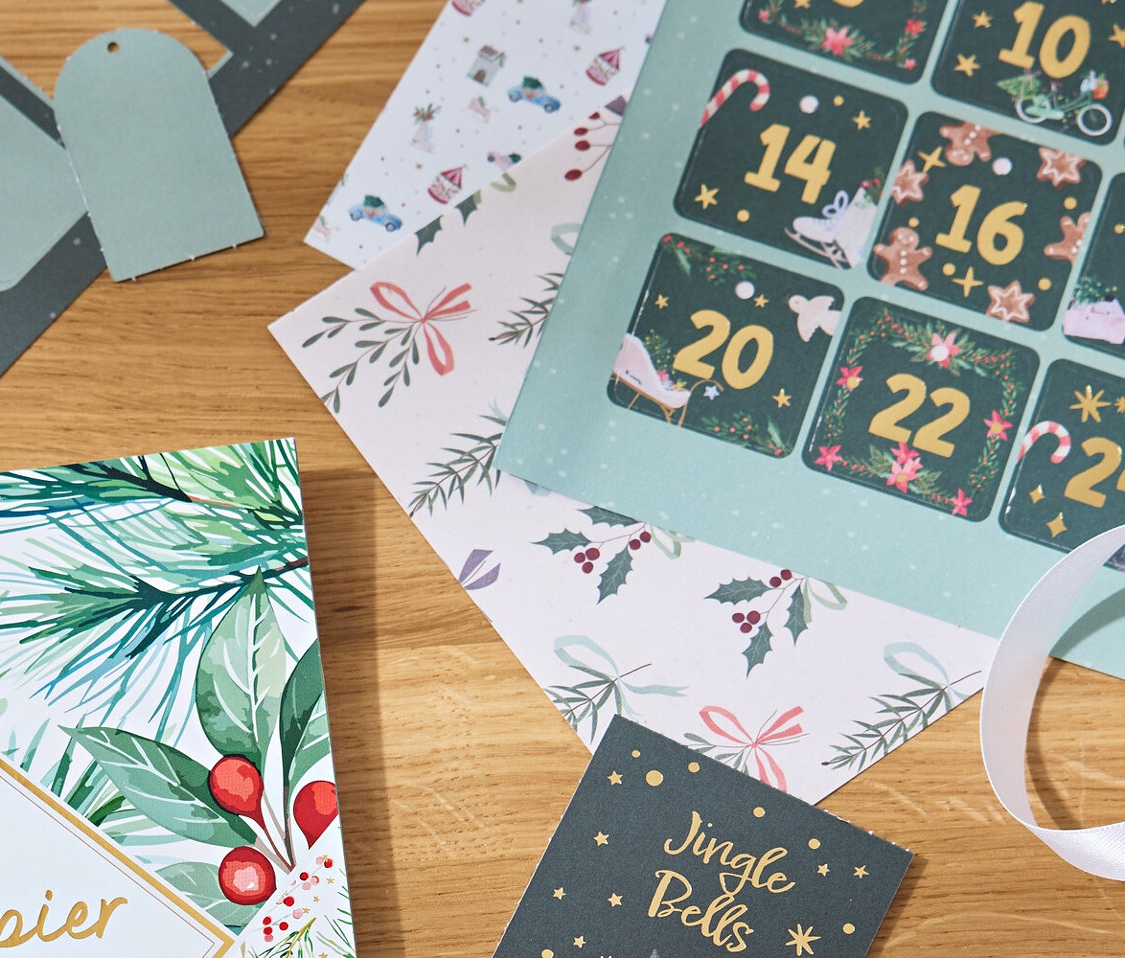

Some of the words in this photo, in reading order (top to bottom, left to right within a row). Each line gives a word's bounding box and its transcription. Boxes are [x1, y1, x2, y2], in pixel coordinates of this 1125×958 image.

[998, 1, 1091, 79] 10
[743, 123, 836, 205] 14
[935, 184, 1029, 266] 16
[672, 309, 774, 390] 20
[868, 373, 971, 458] 22
[1063, 436, 1125, 509] 2
[663, 810, 796, 896] Jingle
[647, 869, 754, 953] Bells
